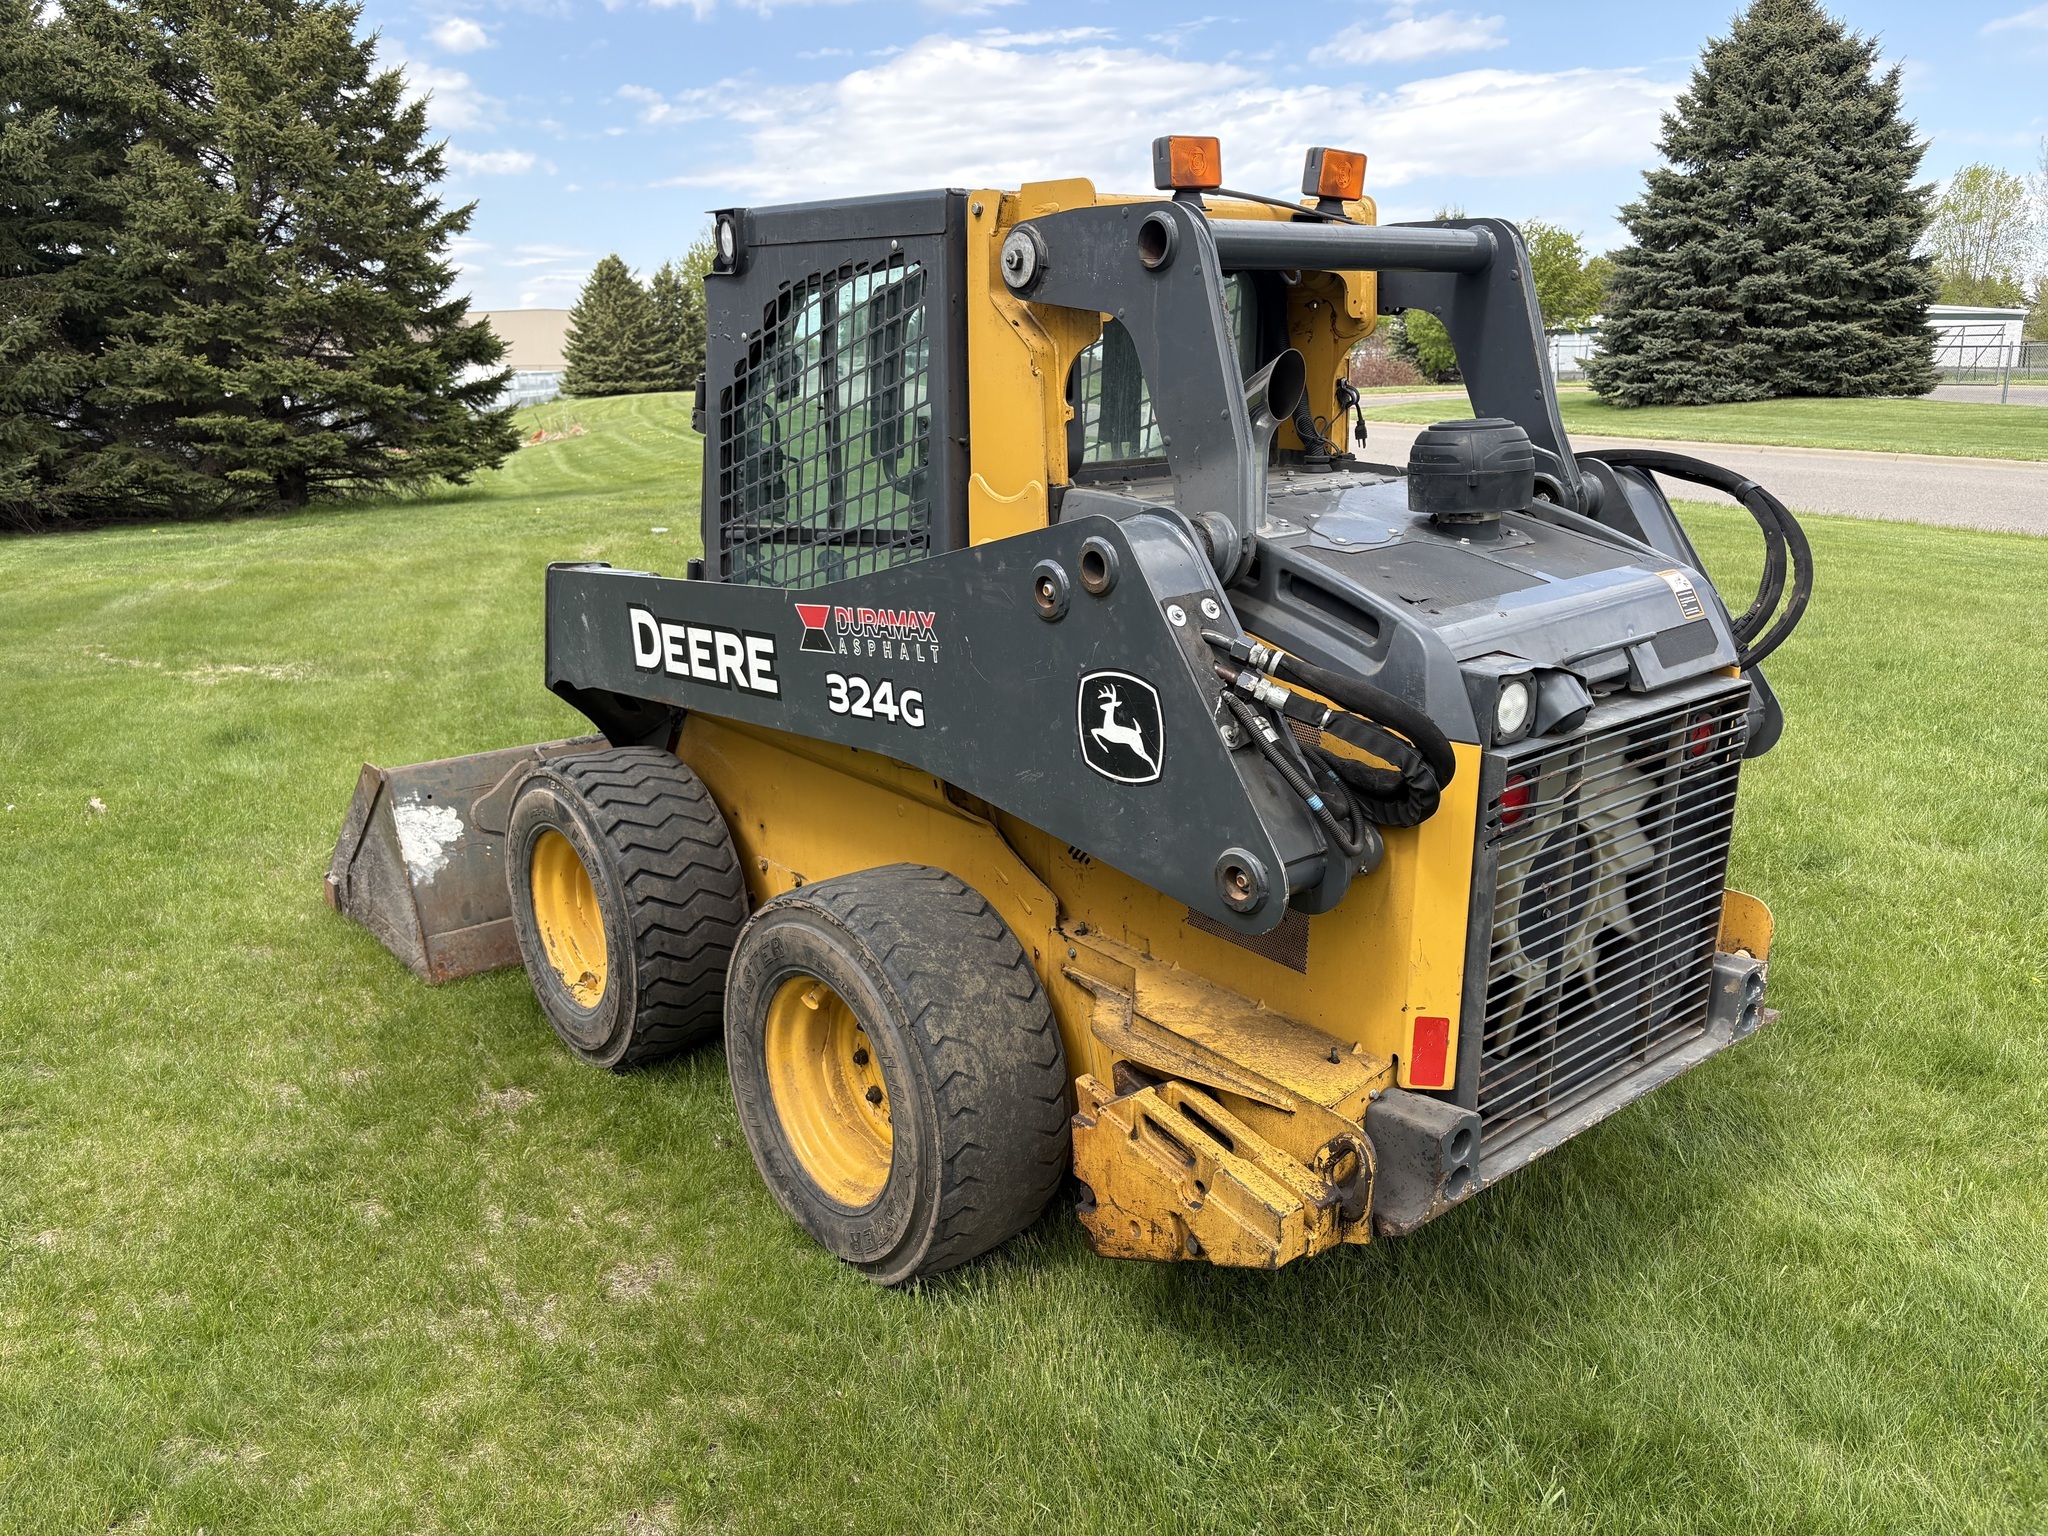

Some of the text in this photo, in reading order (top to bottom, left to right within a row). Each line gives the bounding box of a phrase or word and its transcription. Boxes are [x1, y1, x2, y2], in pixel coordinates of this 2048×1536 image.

[834, 606, 939, 643] DURAMAX
[629, 608, 779, 694] DEERE
[838, 637, 940, 664] ASPHALT
[825, 673, 925, 728] 324G
